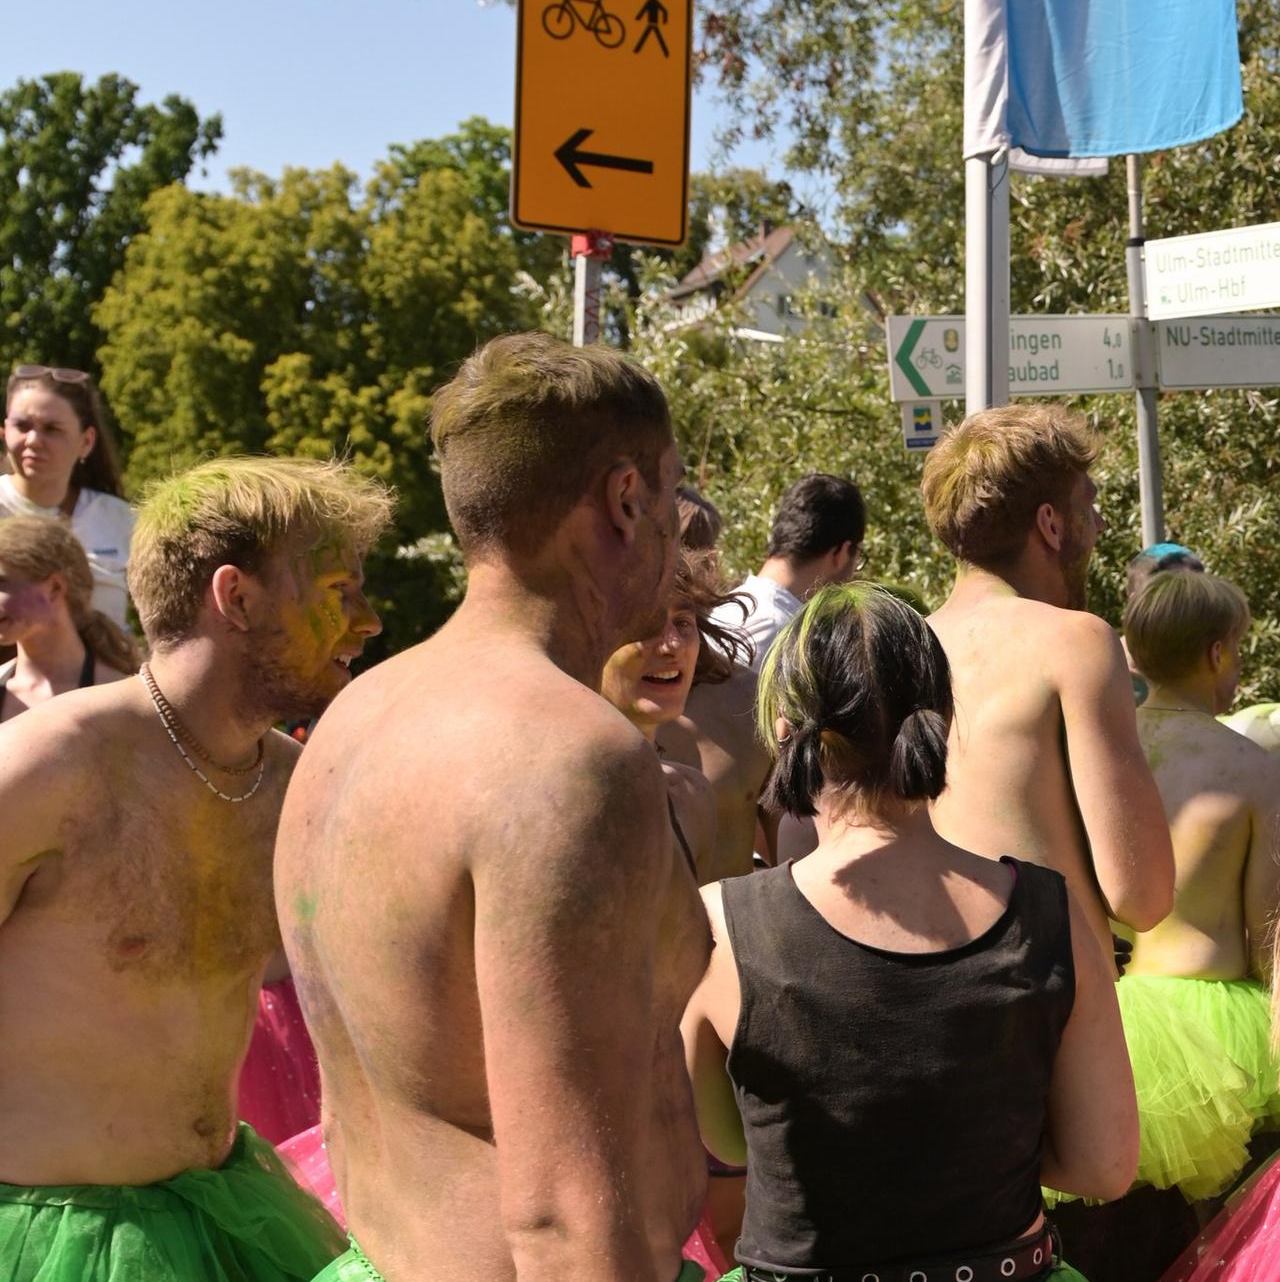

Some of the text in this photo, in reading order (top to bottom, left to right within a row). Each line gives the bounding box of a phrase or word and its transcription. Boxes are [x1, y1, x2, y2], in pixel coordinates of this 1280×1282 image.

[1176, 274, 1246, 304] Ulm-Hbf
[1011, 328, 1062, 355] ingen
[1008, 359, 1060, 383] aubad
